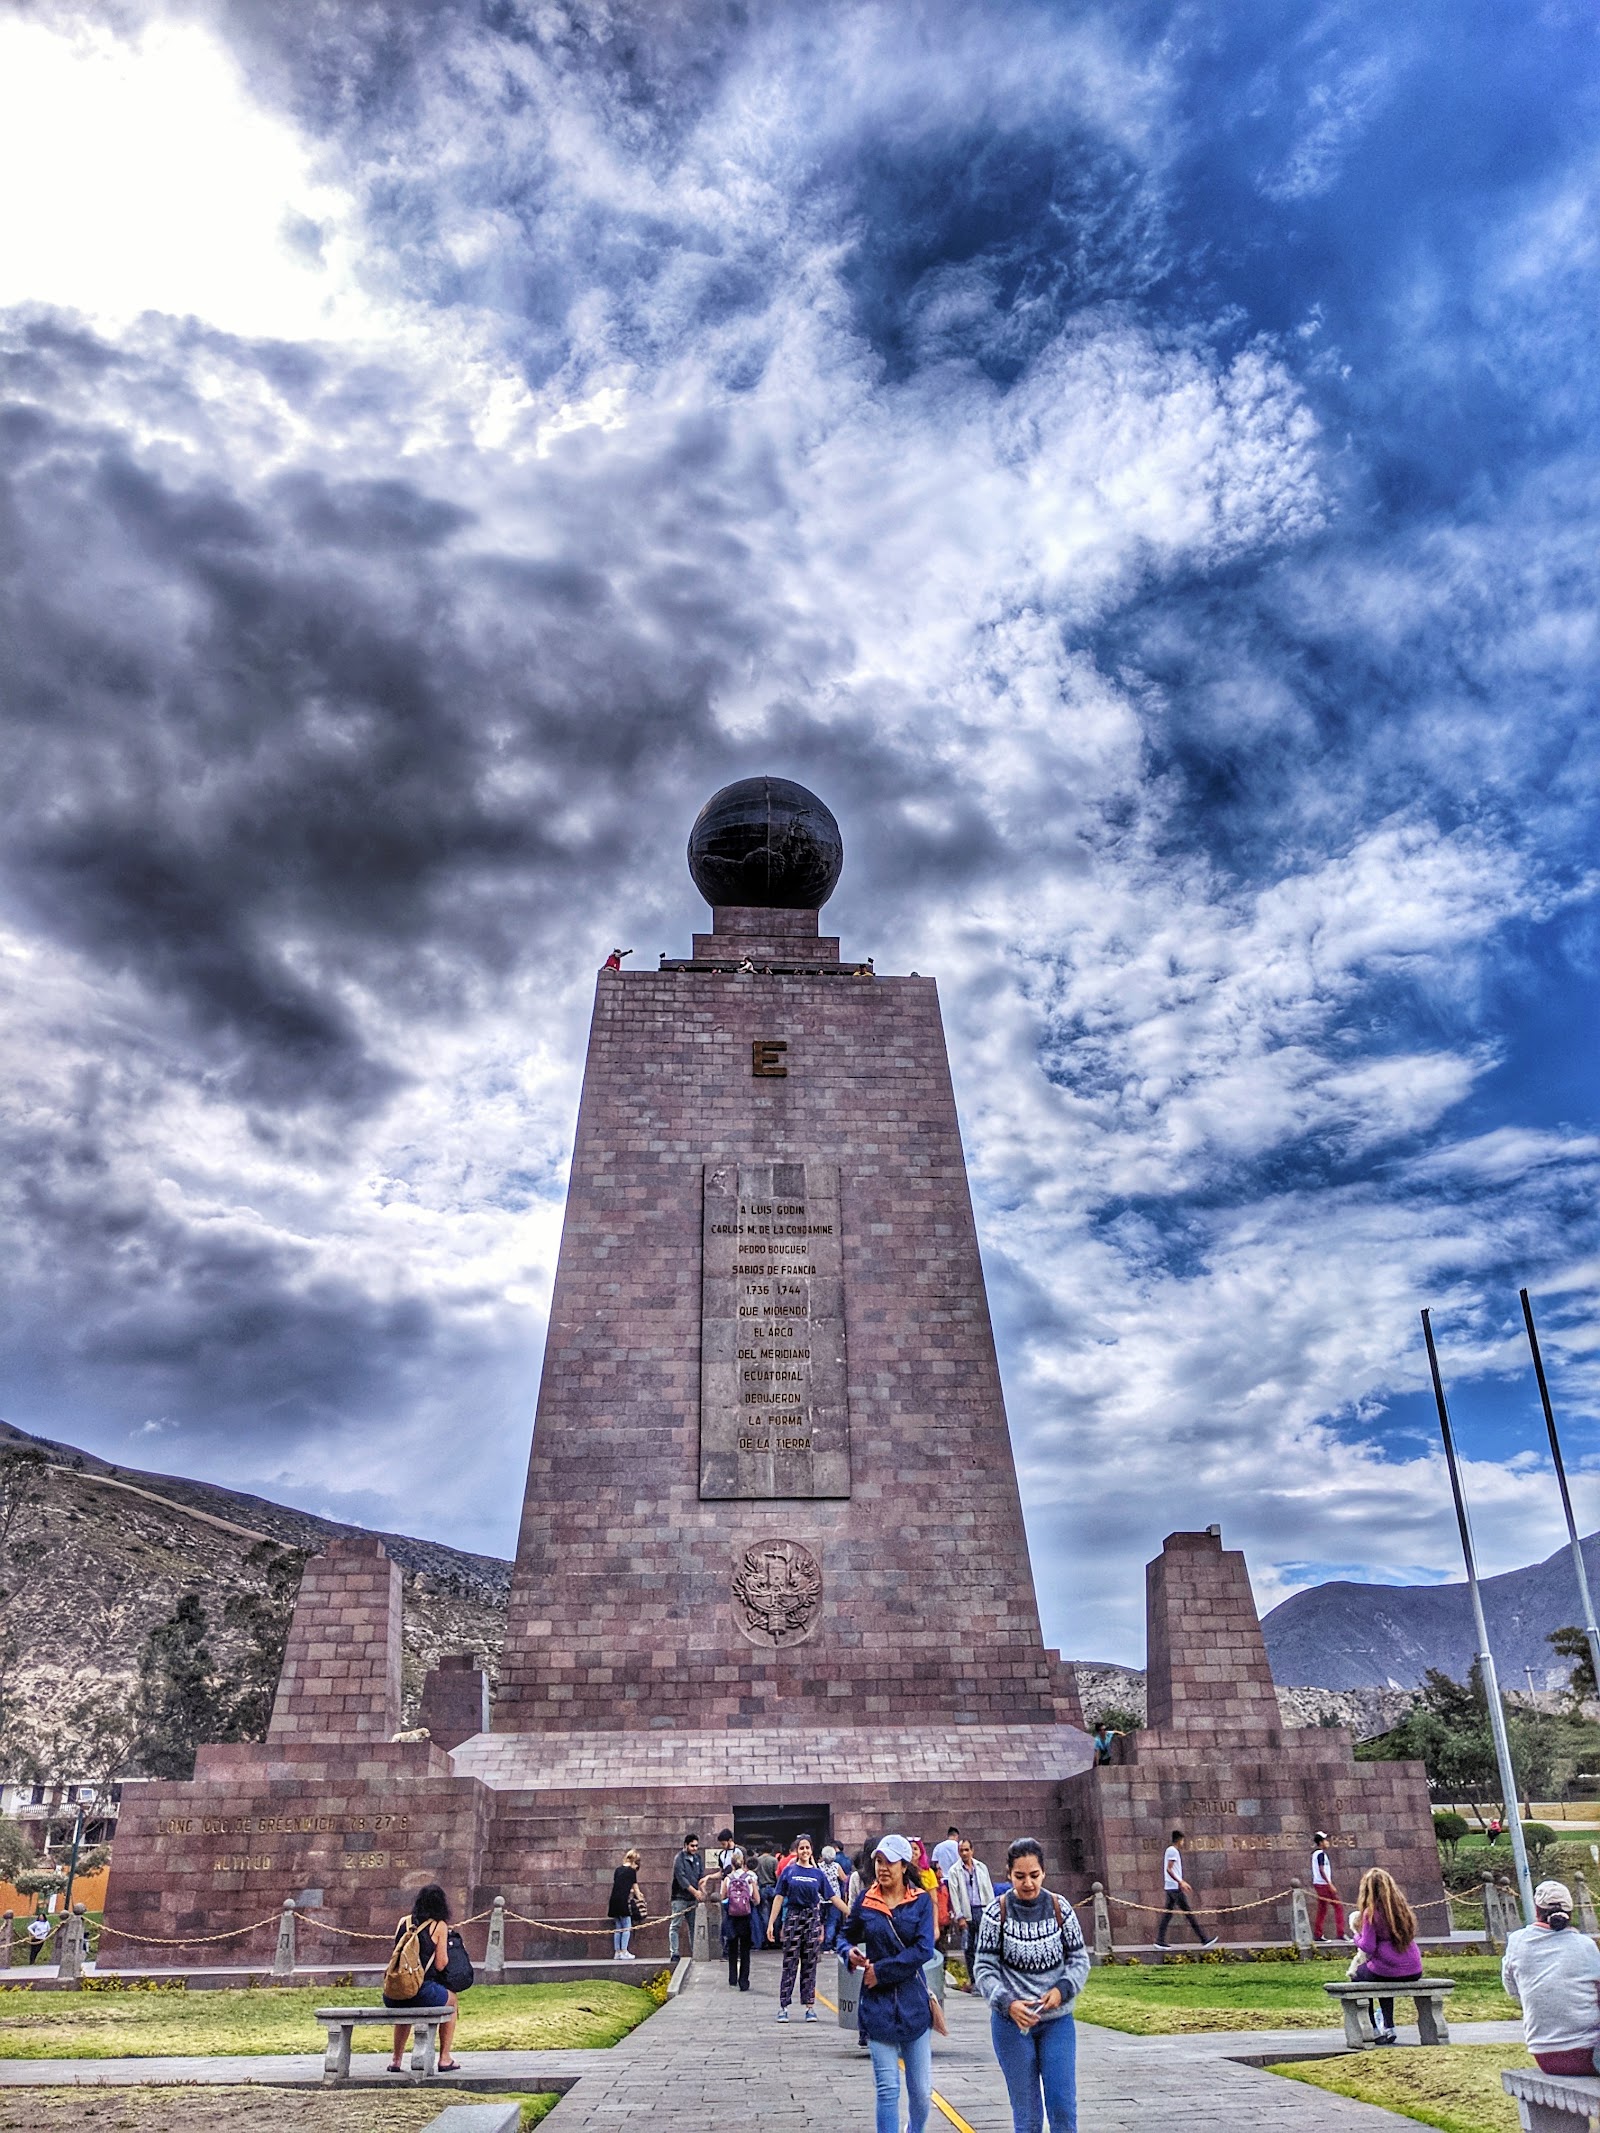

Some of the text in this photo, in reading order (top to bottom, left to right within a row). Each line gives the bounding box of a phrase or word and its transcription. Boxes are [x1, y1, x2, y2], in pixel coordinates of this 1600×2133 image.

[753, 1040, 787, 1077] E
[740, 1205, 805, 1214] A LUIS GODIN
[711, 1224, 744, 1234] CARLOS
[760, 1225, 770, 1234] DE
[773, 1225, 784, 1234] LA
[786, 1225, 833, 1234] CONDAMINE
[738, 1245, 807, 1254] PEDRO BOUGUER
[732, 1265, 816, 1275] SABIOS DE FRANCIA
[739, 1307, 807, 1316] QUE MIDIENDO
[754, 1328, 793, 1337] EL ARCO
[738, 1349, 810, 1359] DEL MERIDIANO
[744, 1371, 804, 1381] ECUATORIAL
[745, 1394, 801, 1403] DEDUJERON
[748, 1416, 803, 1426] LA FORMA
[739, 1439, 811, 1449] DE LA TIERRA
[258, 1818, 335, 1833] GREENWICH
[213, 1855, 271, 1870] ALTITUD
